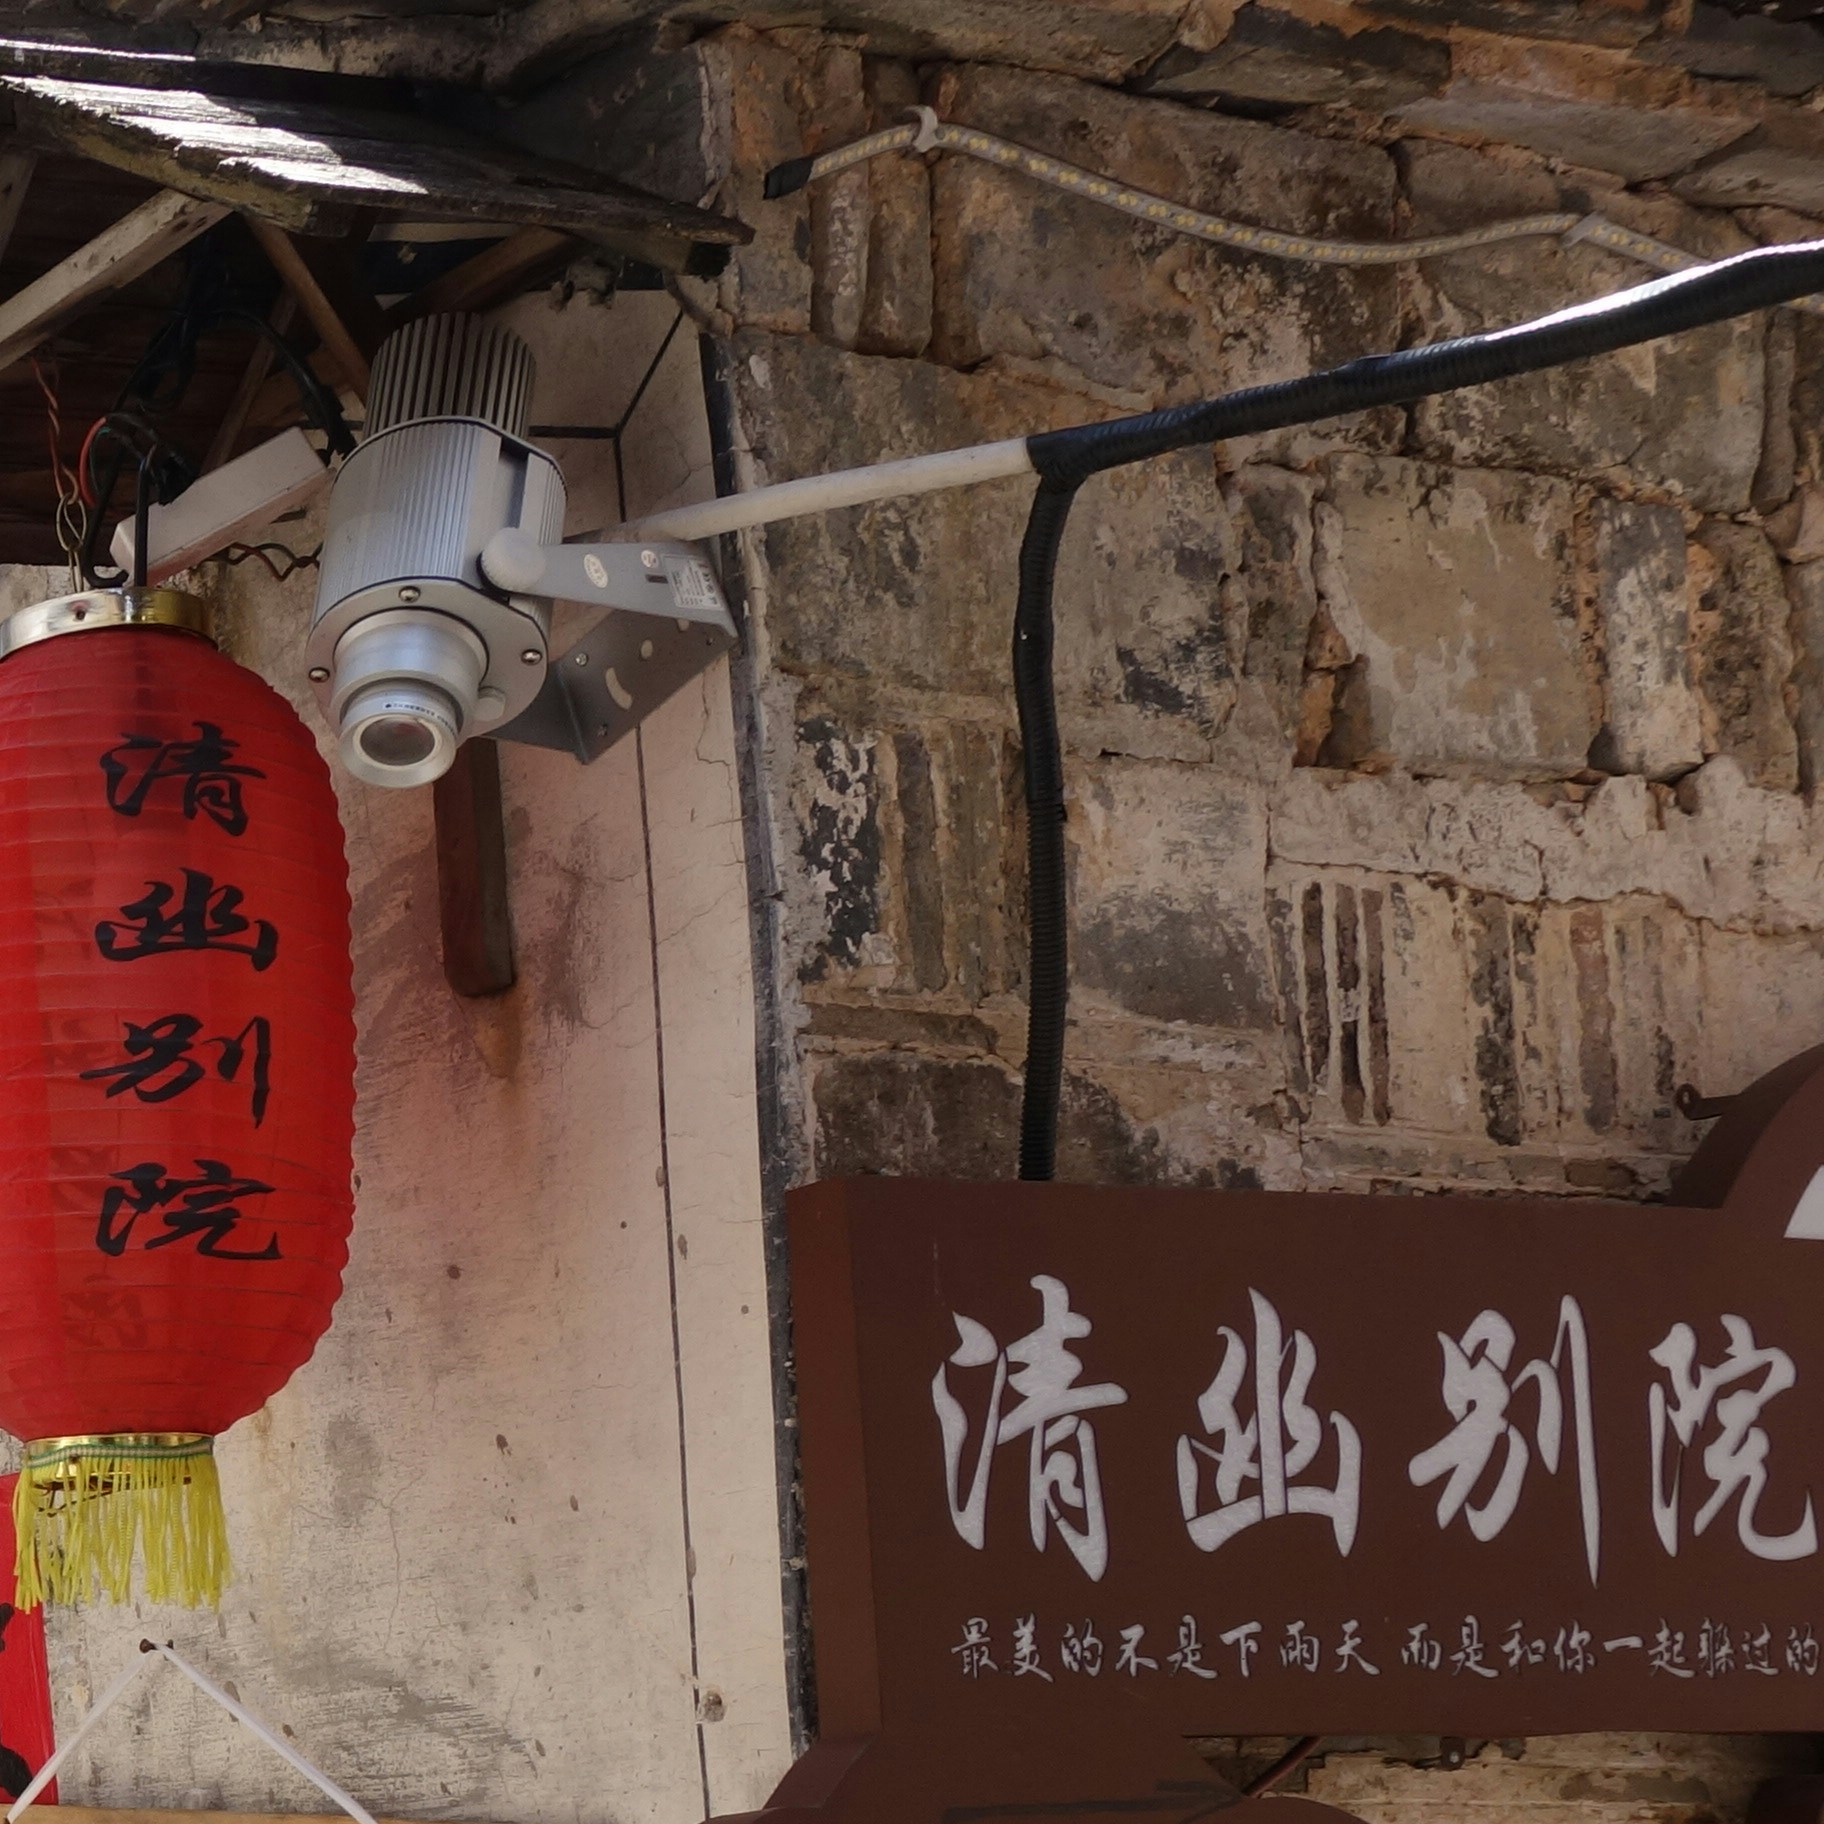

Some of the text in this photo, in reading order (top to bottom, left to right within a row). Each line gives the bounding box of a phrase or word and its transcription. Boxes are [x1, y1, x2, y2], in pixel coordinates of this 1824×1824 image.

[80, 720, 284, 1261] 清幽别院
[932, 1273, 1819, 1590] 清幽别院
[950, 1612, 1382, 1684] 最美的不是下雨天
